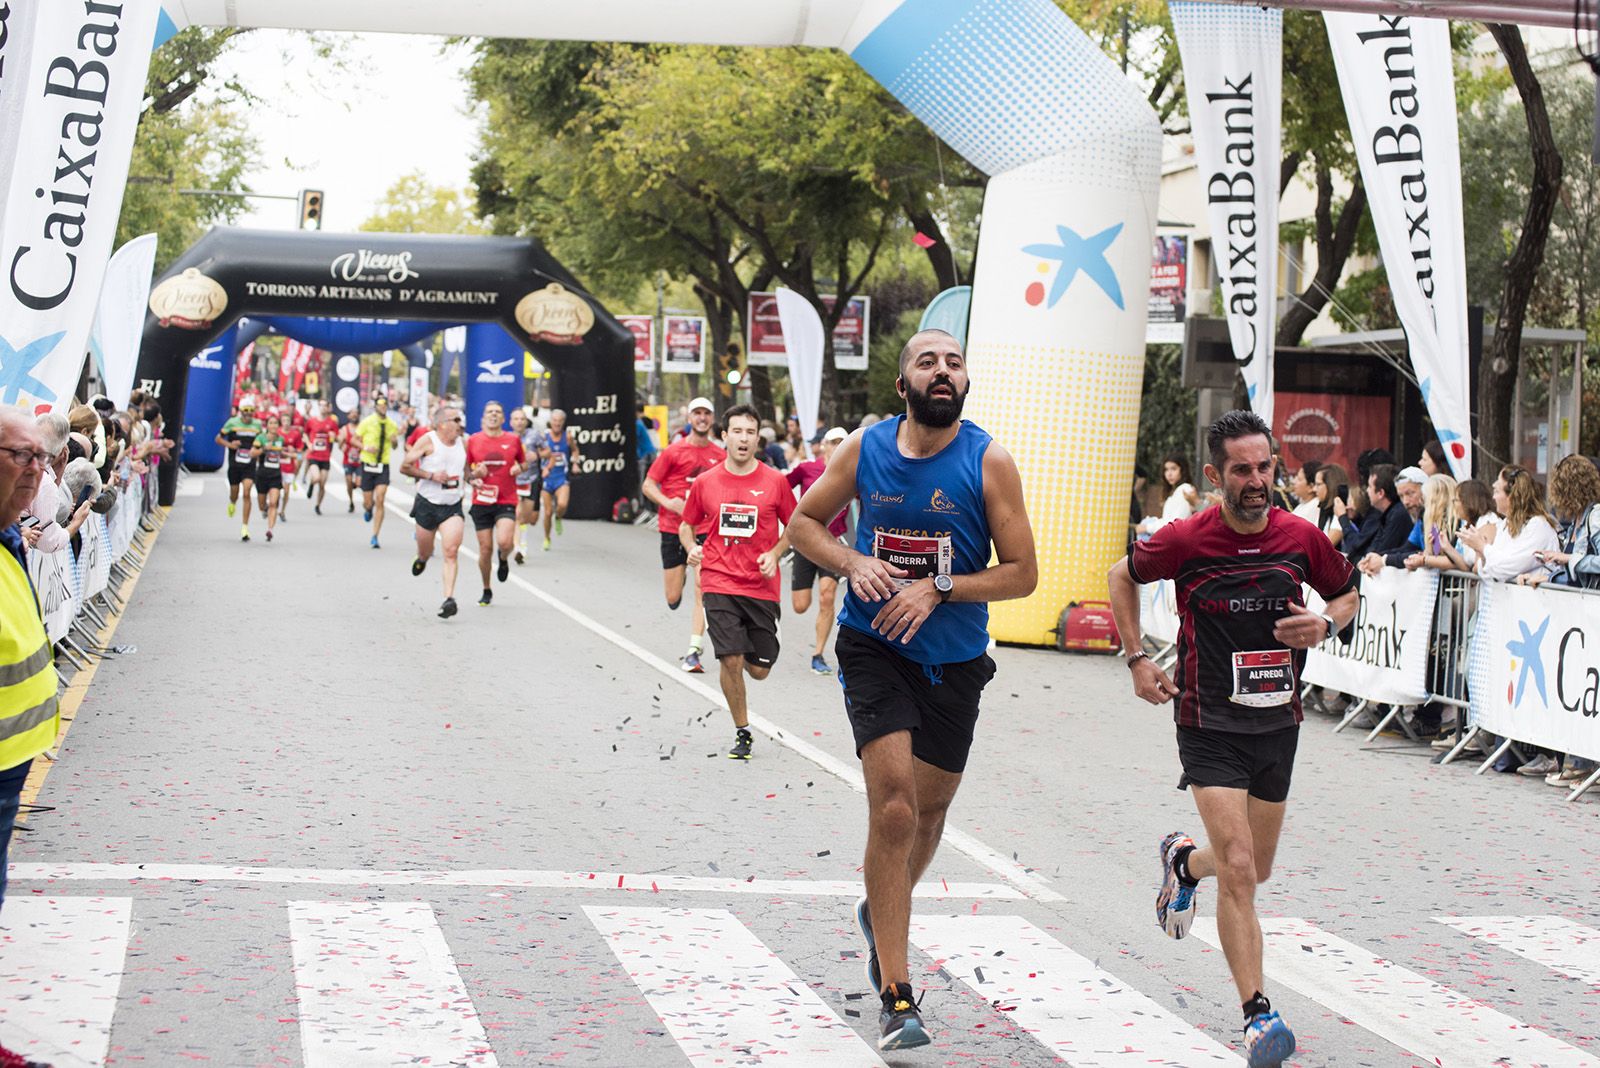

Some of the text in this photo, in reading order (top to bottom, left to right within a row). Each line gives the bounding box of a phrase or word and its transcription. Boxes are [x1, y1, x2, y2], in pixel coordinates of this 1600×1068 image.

[1356, 14, 1437, 335] aixaBank
[246, 282, 498, 304] TORRONS ARTESANS D'AGRAMUNT
[942, 545, 950, 558] 381
[888, 554, 928, 566] ABDERRA
[1249, 669, 1284, 680] ALFREDO
[1259, 682, 1277, 692] 100
